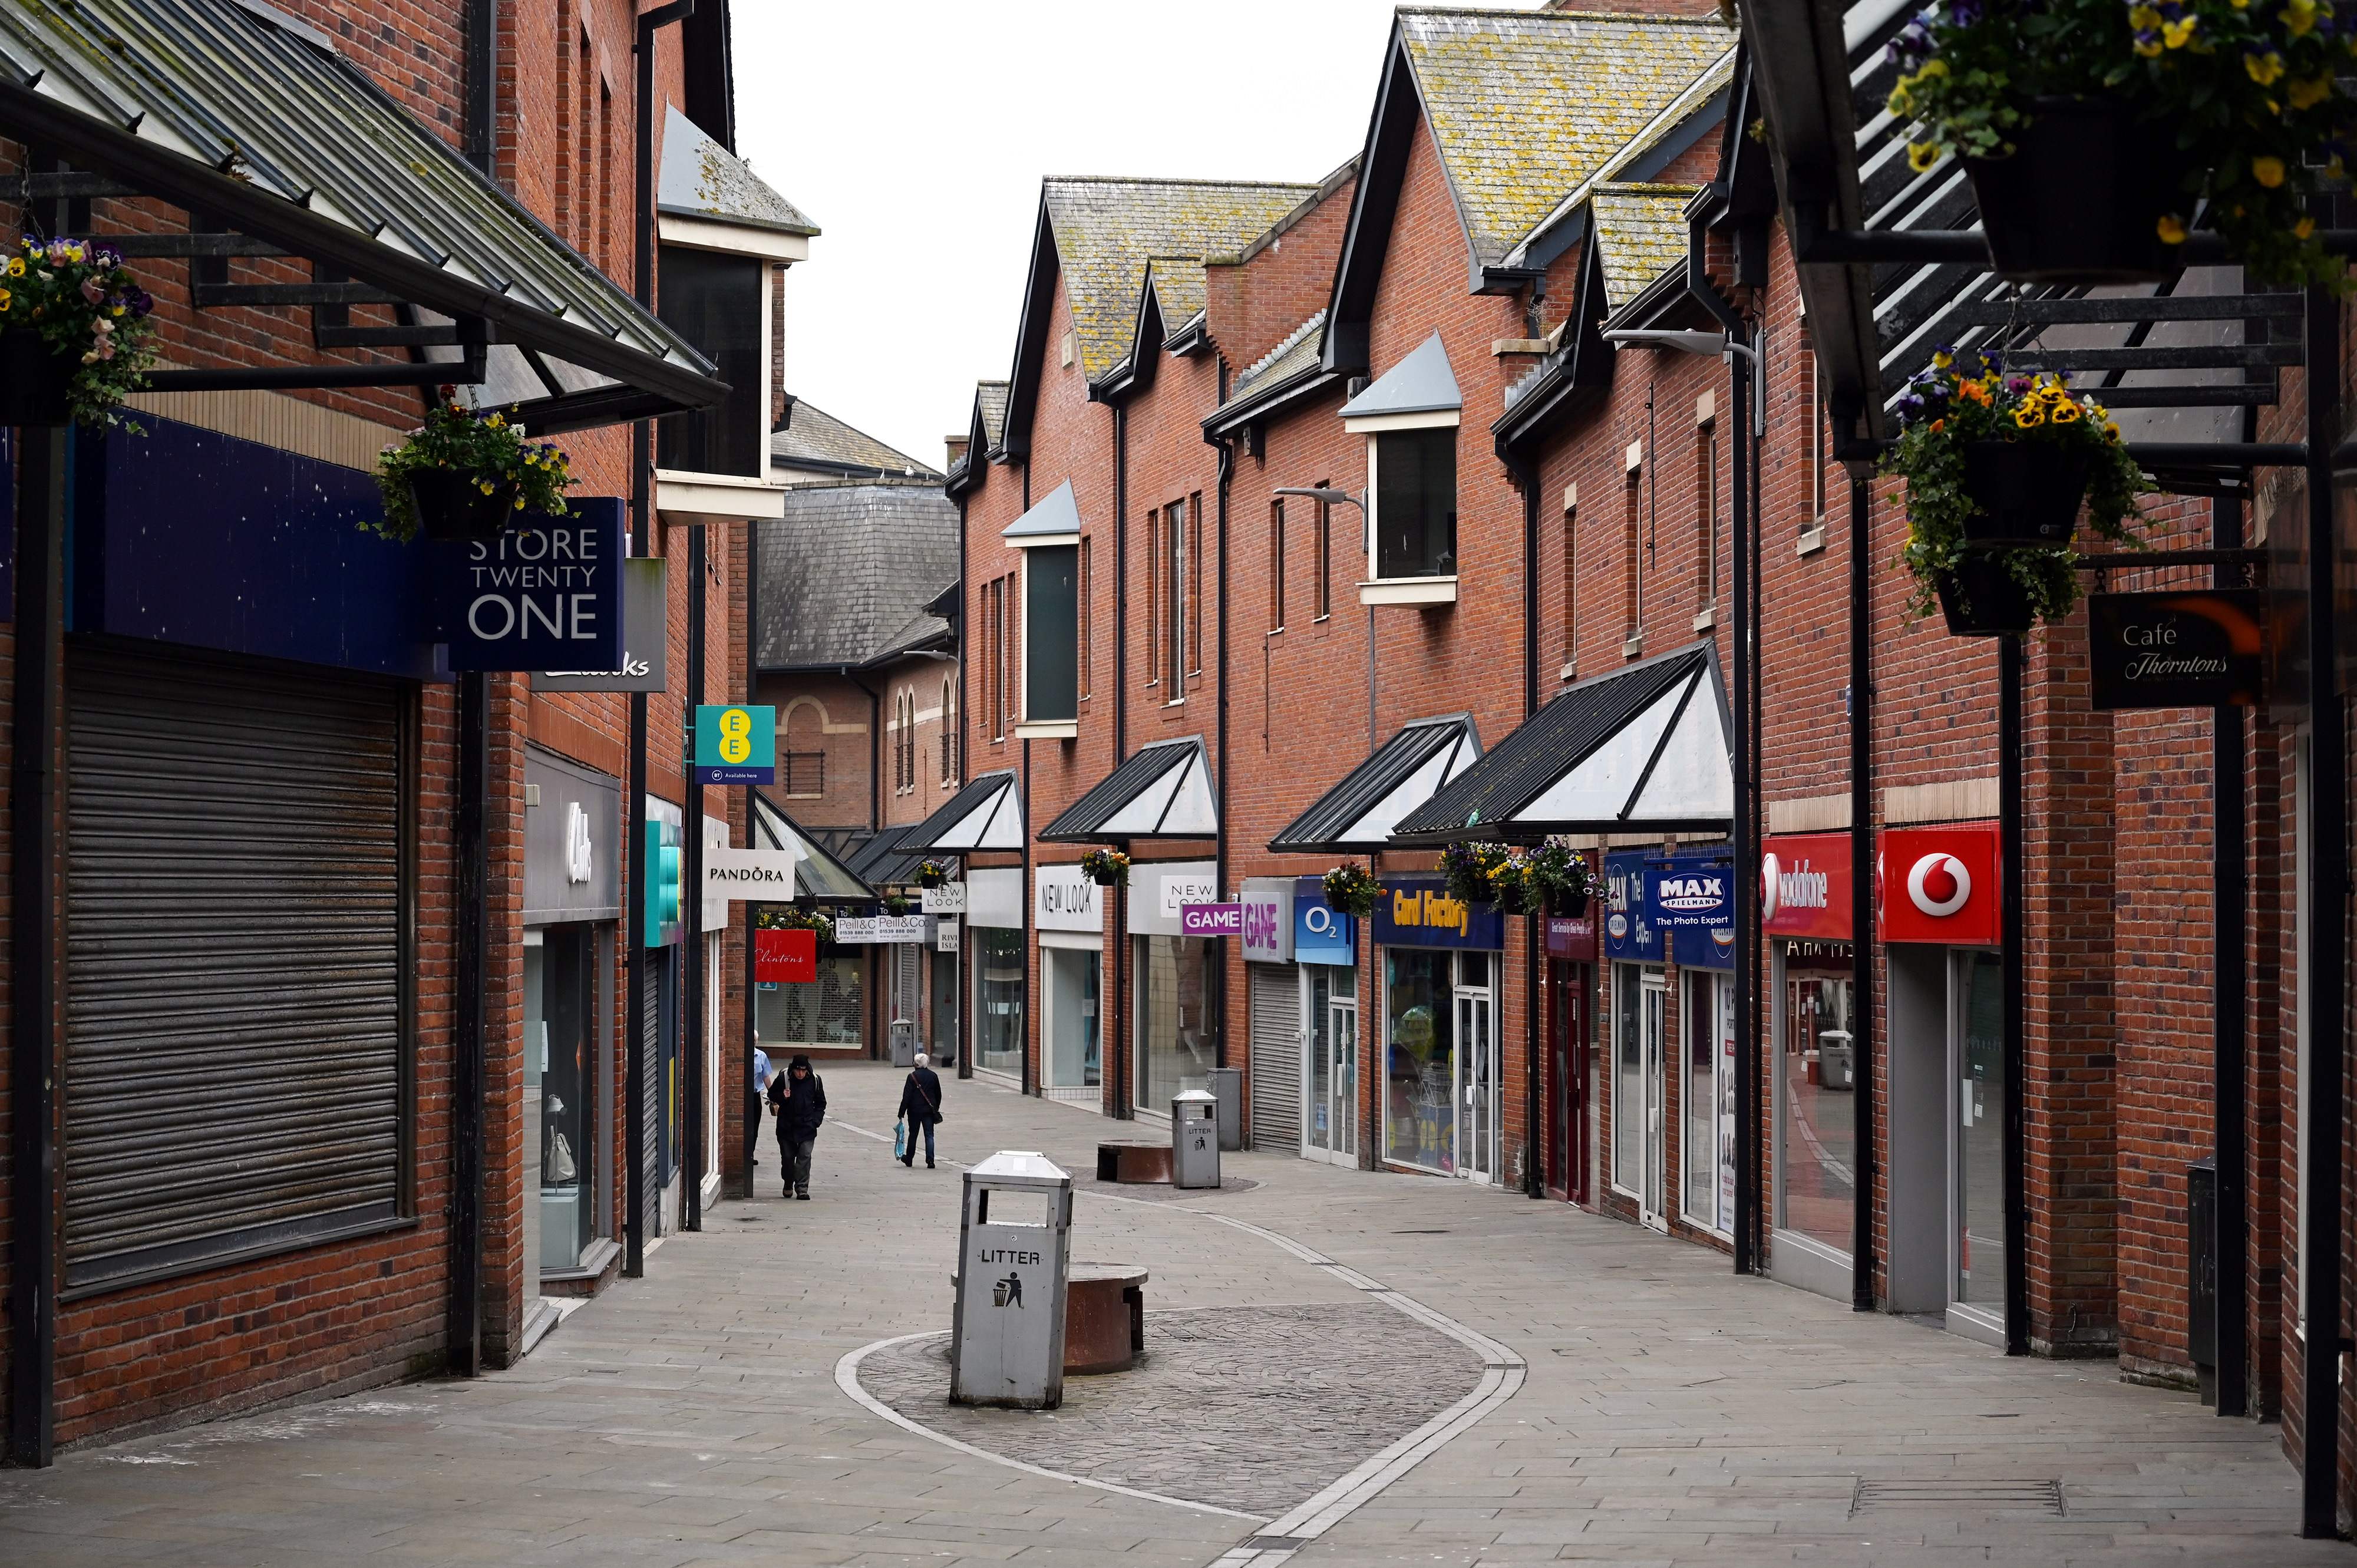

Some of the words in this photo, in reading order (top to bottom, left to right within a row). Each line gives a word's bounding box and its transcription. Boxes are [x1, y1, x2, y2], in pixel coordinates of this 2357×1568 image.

[470, 529, 597, 560] STORE
[470, 566, 596, 587] TWENTY
[468, 593, 597, 640] ONE
[2125, 652, 2227, 679] Thorntons
[710, 867, 784, 882] PANDORA
[1631, 872, 1641, 901] The
[1779, 859, 1827, 907] vodafone
[930, 889, 960, 897] NEW
[1042, 884, 1062, 913] NEW
[1067, 884, 1092, 913] LOOK
[1172, 885, 1213, 895] NEW
[1608, 877, 1627, 910] MAX
[1660, 879, 1722, 897] MAX
[927, 898, 963, 906] LOOK
[1394, 889, 1421, 926] Card
[1424, 890, 1468, 937] Factory
[1186, 911, 1240, 928] GAME
[1244, 903, 1277, 949] GAME
[1656, 917, 1674, 926] The
[1675, 916, 1698, 925] Photo
[1701, 916, 1729, 926] Expert
[981, 1249, 1040, 1265] LITTER
